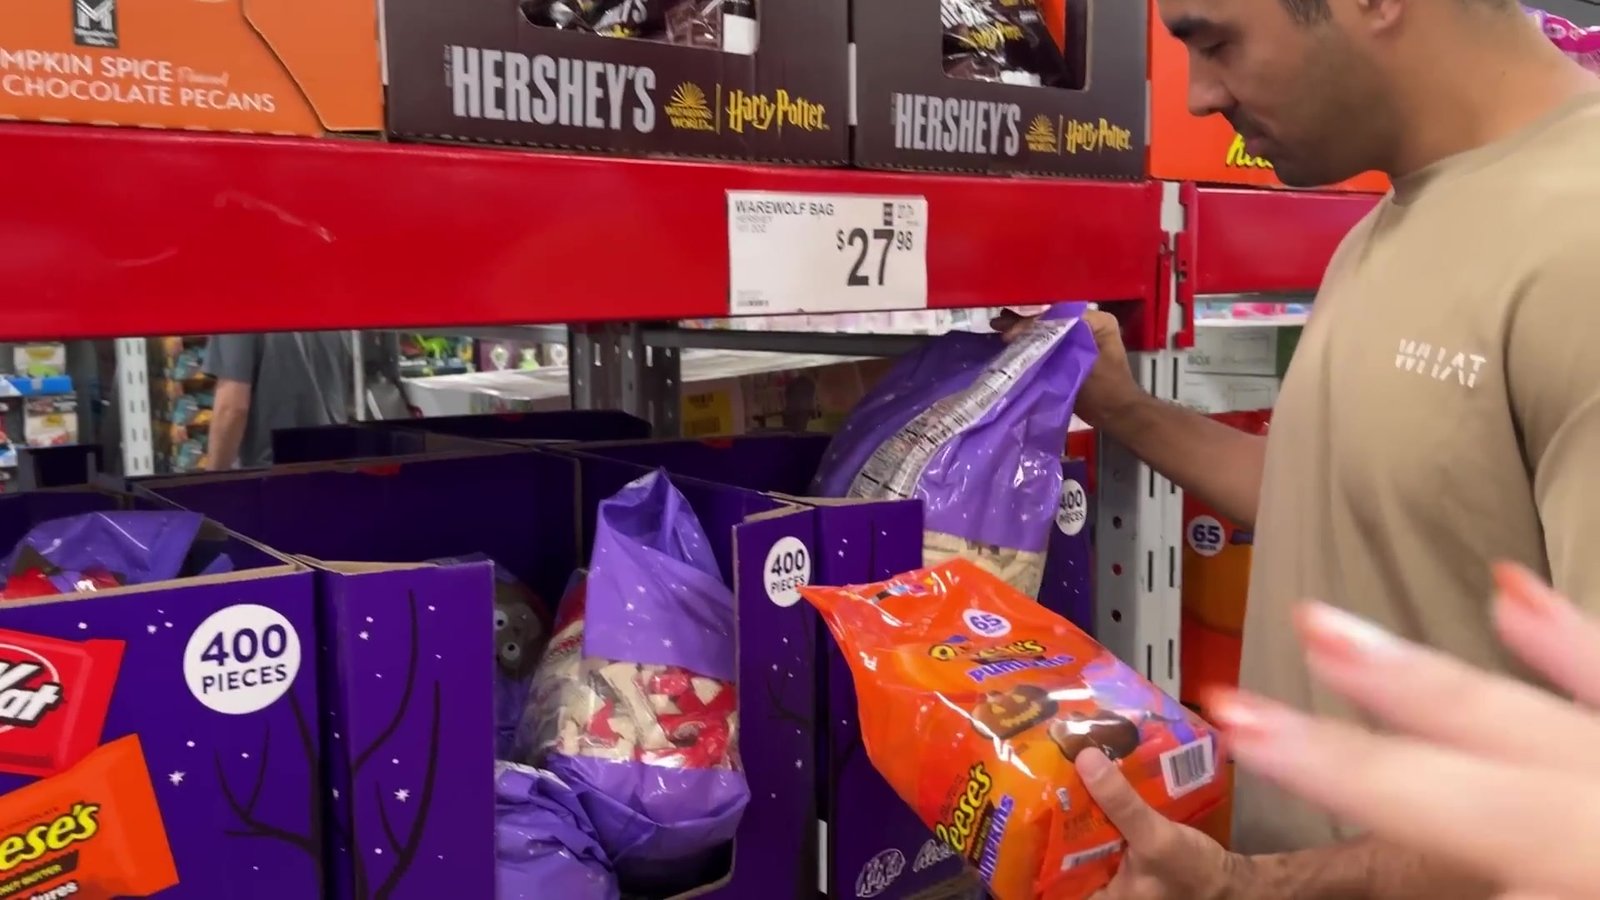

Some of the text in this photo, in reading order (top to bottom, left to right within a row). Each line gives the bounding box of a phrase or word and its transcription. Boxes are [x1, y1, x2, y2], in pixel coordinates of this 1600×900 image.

[101, 55, 174, 83] SPICE
[2, 73, 175, 106] CHOCOLATE
[180, 87, 277, 113] PECANS
[451, 46, 657, 133] HERSHEY'S
[725, 89, 828, 138] Harry Potter
[895, 93, 1021, 157] HERSHEY'S
[1065, 118, 1099, 154] Harry
[735, 200, 835, 216] WAREWOLF BAG
[1060, 489, 1083, 512] 400
[1192, 524, 1221, 544] 65
[771, 549, 806, 577] 400
[970, 614, 1003, 631] 65
[200, 623, 288, 667] 400
[201, 663, 288, 695] PIECES
